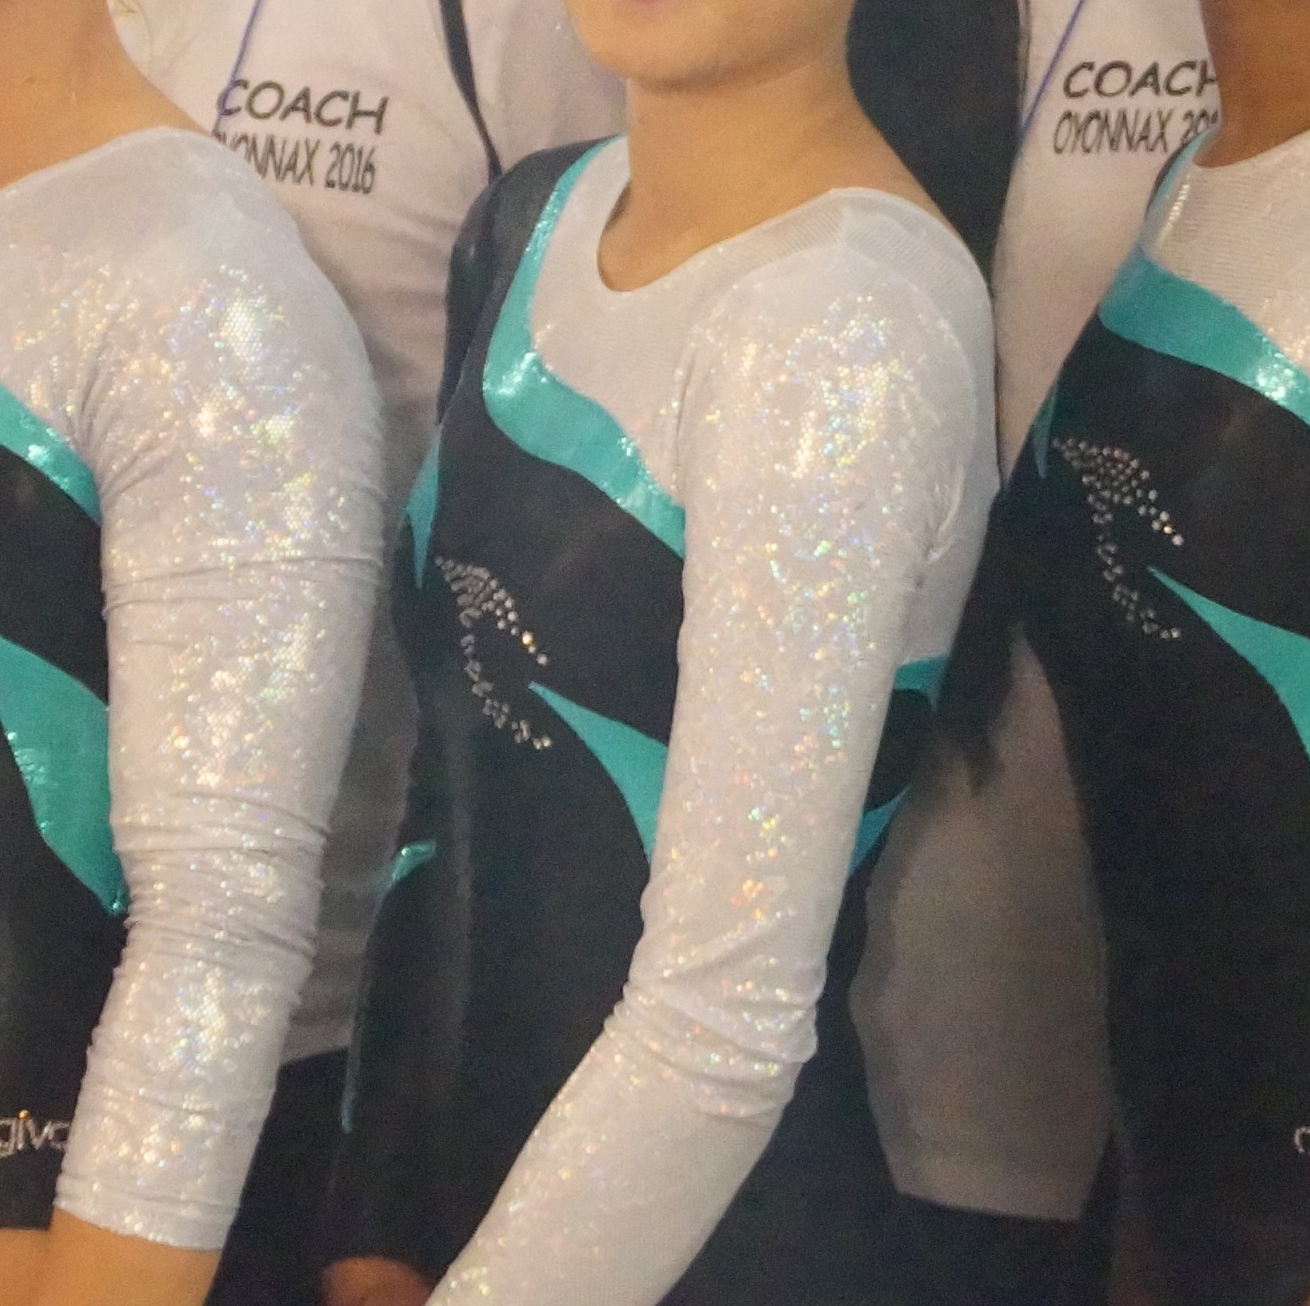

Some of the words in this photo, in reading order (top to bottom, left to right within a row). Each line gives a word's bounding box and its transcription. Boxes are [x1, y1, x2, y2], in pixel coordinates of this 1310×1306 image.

[217, 78, 389, 135] COACH
[1052, 107, 1173, 154] OYONNAX
[324, 141, 376, 195] 2016
